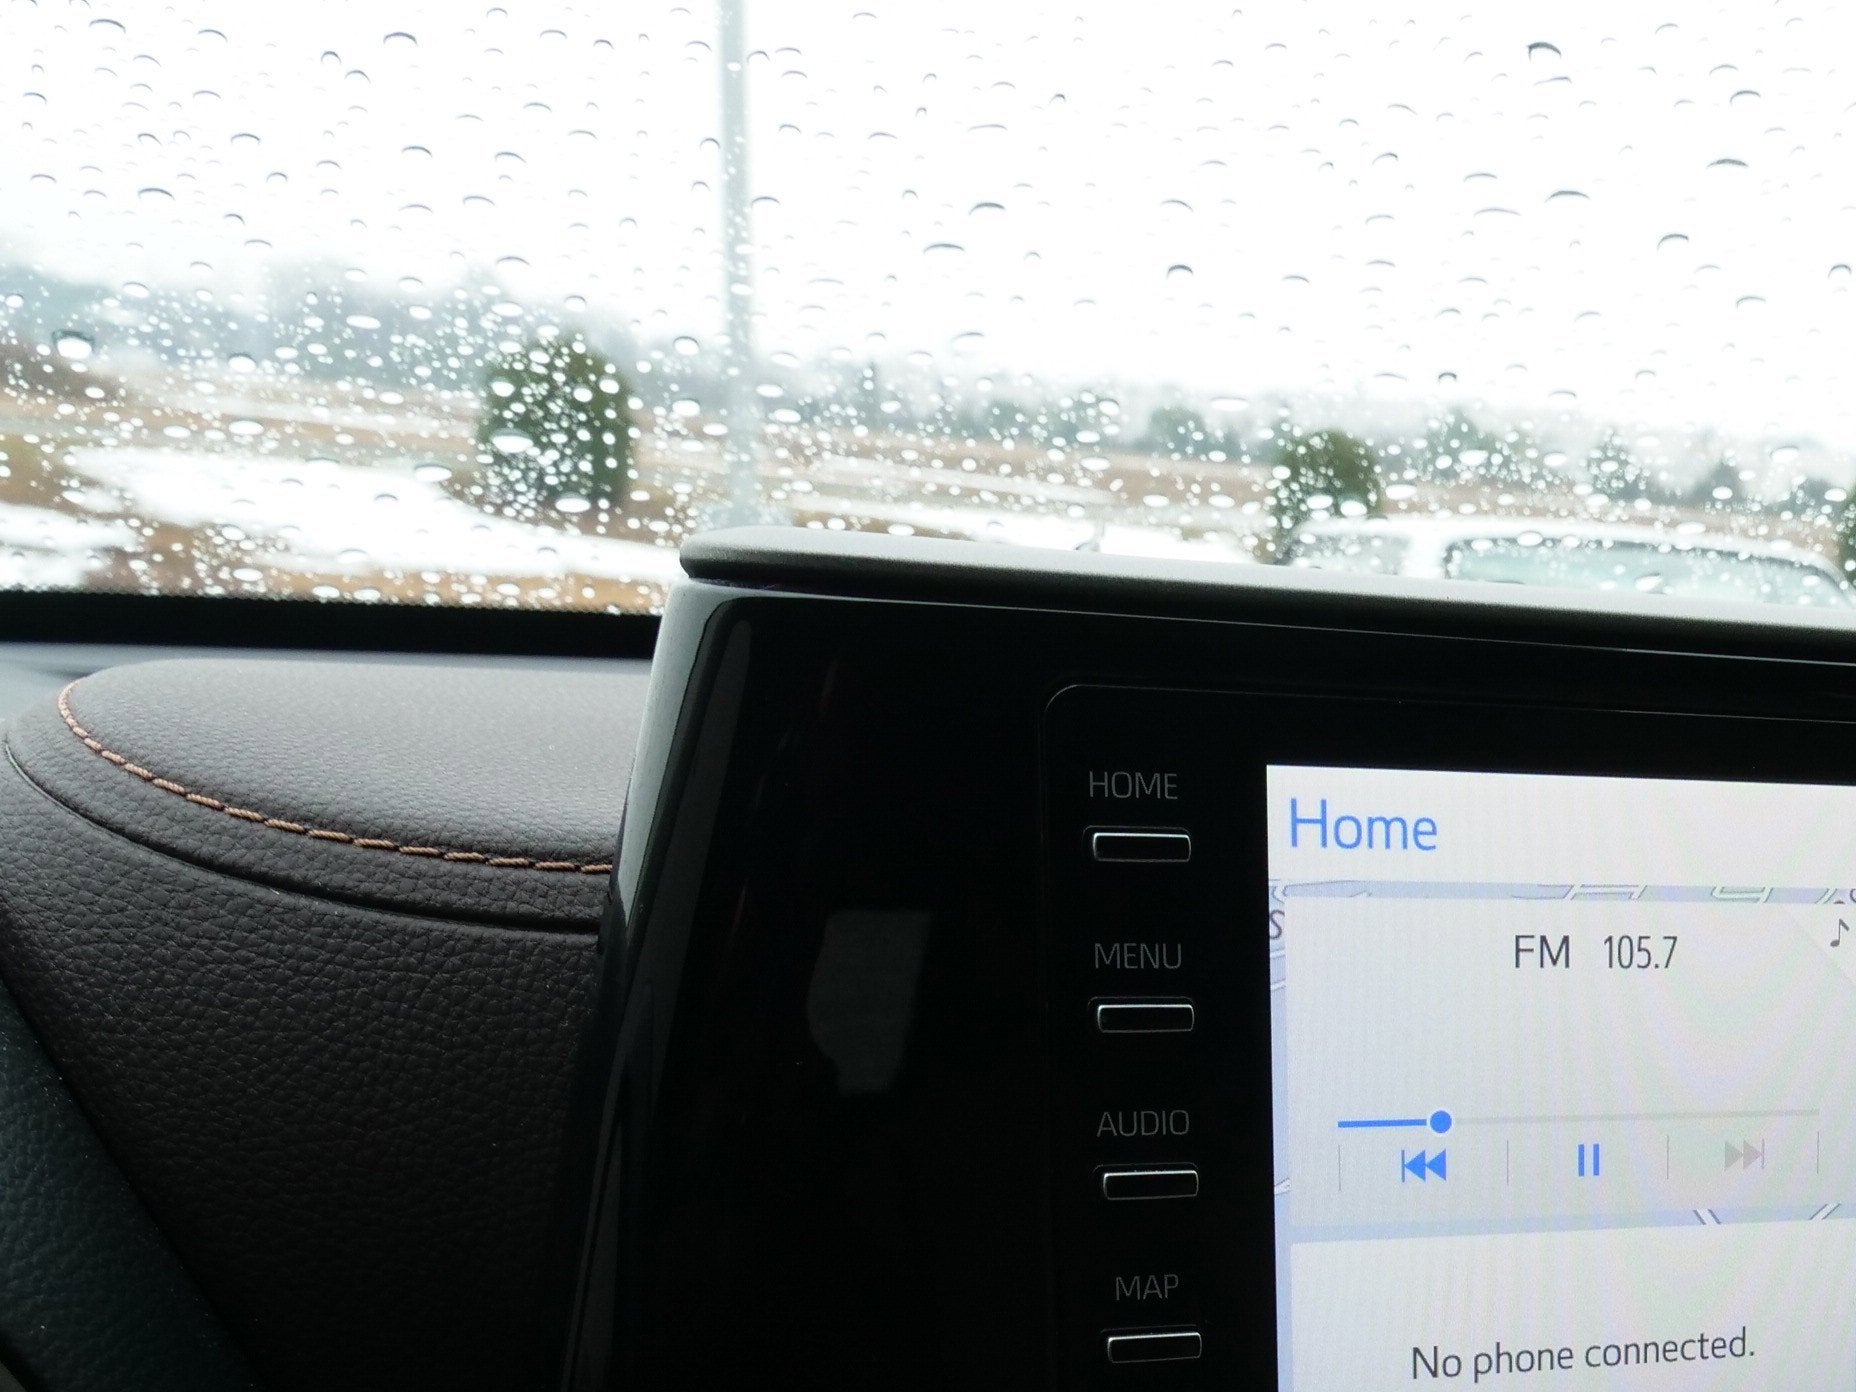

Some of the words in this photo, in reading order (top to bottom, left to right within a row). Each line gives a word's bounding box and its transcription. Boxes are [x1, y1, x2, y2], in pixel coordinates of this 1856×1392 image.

[1088, 770, 1179, 801] HOME
[1290, 798, 1439, 852] Home
[1094, 942, 1183, 970] MENU
[1513, 935, 1571, 969] FM
[1603, 935, 1679, 970] 105.7
[1096, 1109, 1191, 1138] AUDIO
[1115, 1273, 1180, 1301] MAP
[1411, 1345, 1463, 1380] No
[1472, 1343, 1575, 1384] phone
[1584, 1325, 1756, 1369] connected.
